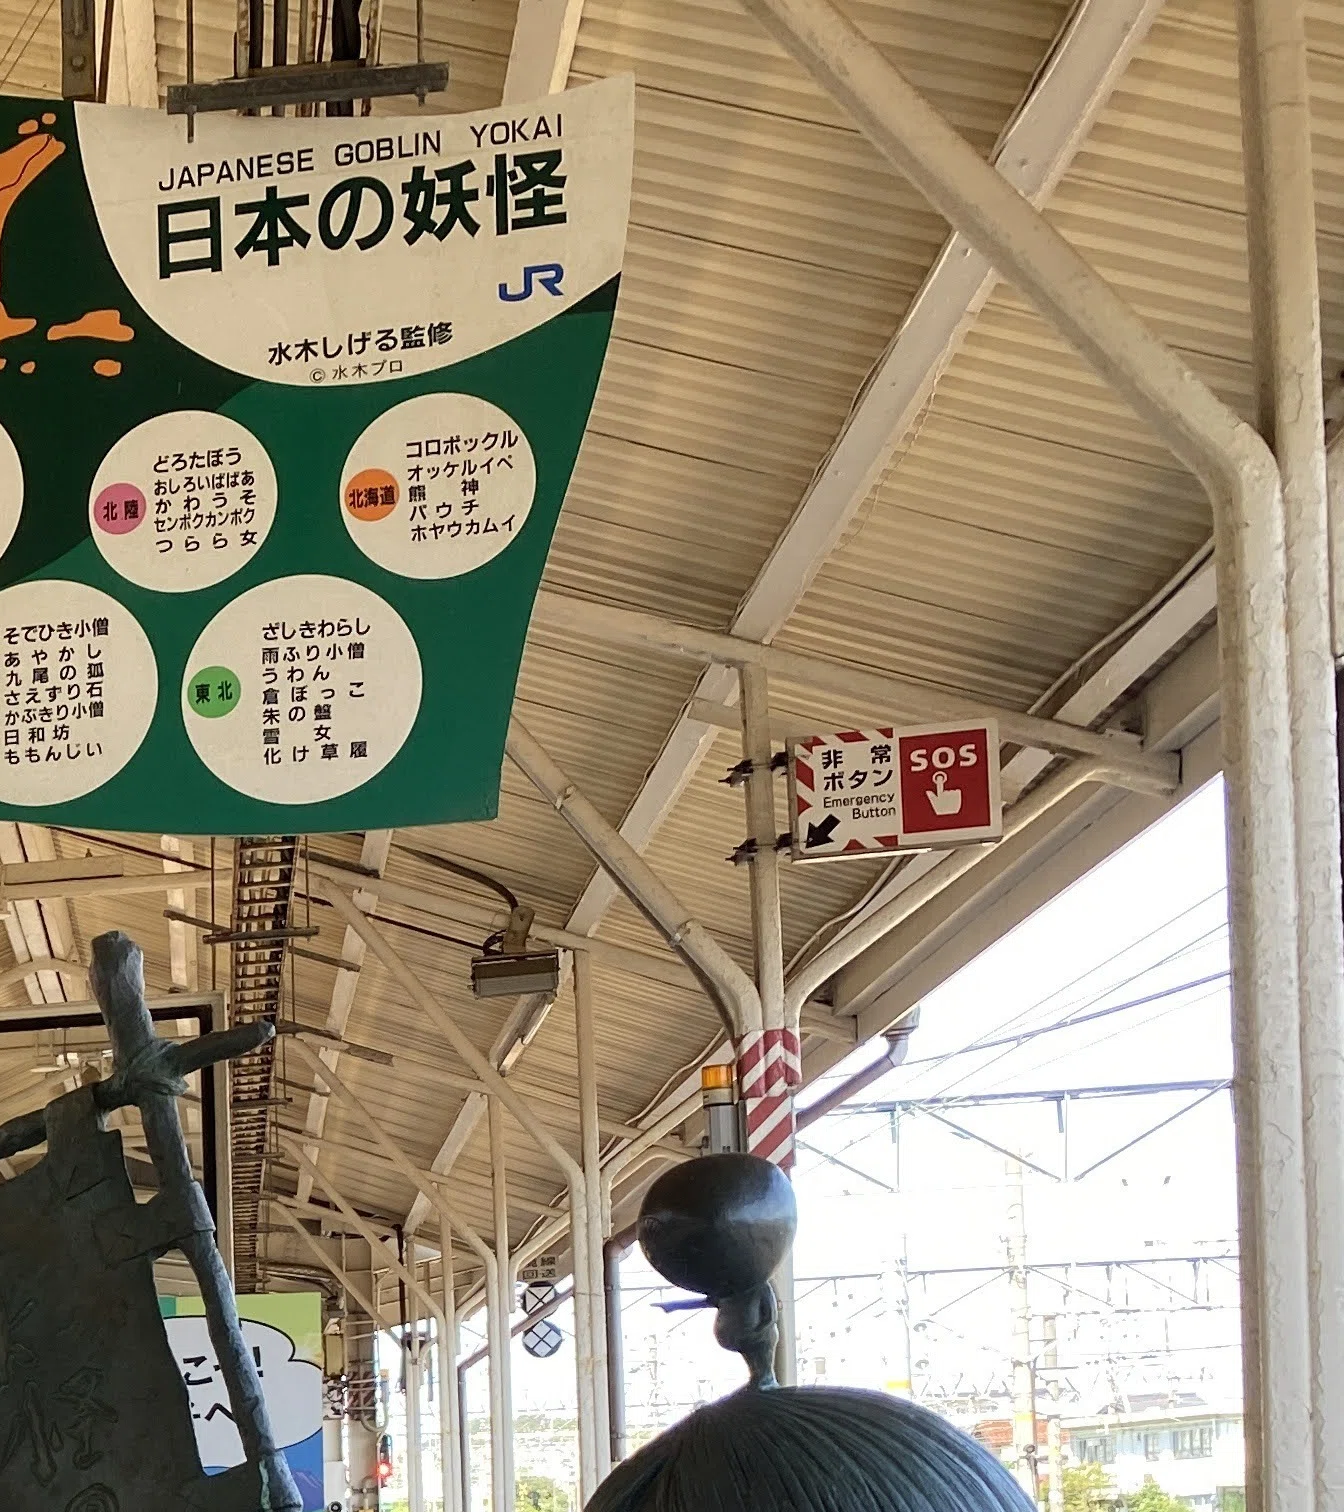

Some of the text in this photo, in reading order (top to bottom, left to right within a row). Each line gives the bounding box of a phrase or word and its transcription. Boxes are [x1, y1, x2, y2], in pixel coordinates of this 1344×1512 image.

[159, 114, 562, 192] JAPANESE GOBLIN YOKAI
[157, 150, 567, 279] 日本の妖怪
[498, 263, 564, 302] JR
[268, 322, 453, 366] 水木しげる監修
[406, 430, 518, 458] コロボックル
[153, 448, 241, 472] どろたぼう
[155, 470, 255, 495] おしろいばばあ
[155, 490, 256, 514] かわうそ
[349, 485, 395, 509] 北海道
[103, 500, 138, 521] 北陸
[411, 515, 515, 541] ホヤウカムイ
[156, 530, 258, 552] つらら女
[3, 617, 109, 644] そでひき小僧
[263, 618, 370, 640] ざしきわらし
[4, 644, 101, 668] あやかし
[262, 643, 364, 664] 雨ふり小僧
[6, 663, 104, 687] 九尾の狐
[262, 665, 330, 684] うわん
[4, 681, 103, 706] さえずり石
[195, 681, 233, 703] 東北
[5, 701, 104, 726] かぶきり小僧
[4, 725, 69, 746] 日和坊
[4, 743, 102, 765] ももんじい
[822, 745, 891, 769] 非常
[910, 744, 977, 772] SOS
[824, 770, 893, 791] ボタン
[823, 792, 894, 808] Emergency
[852, 806, 896, 820] Button
